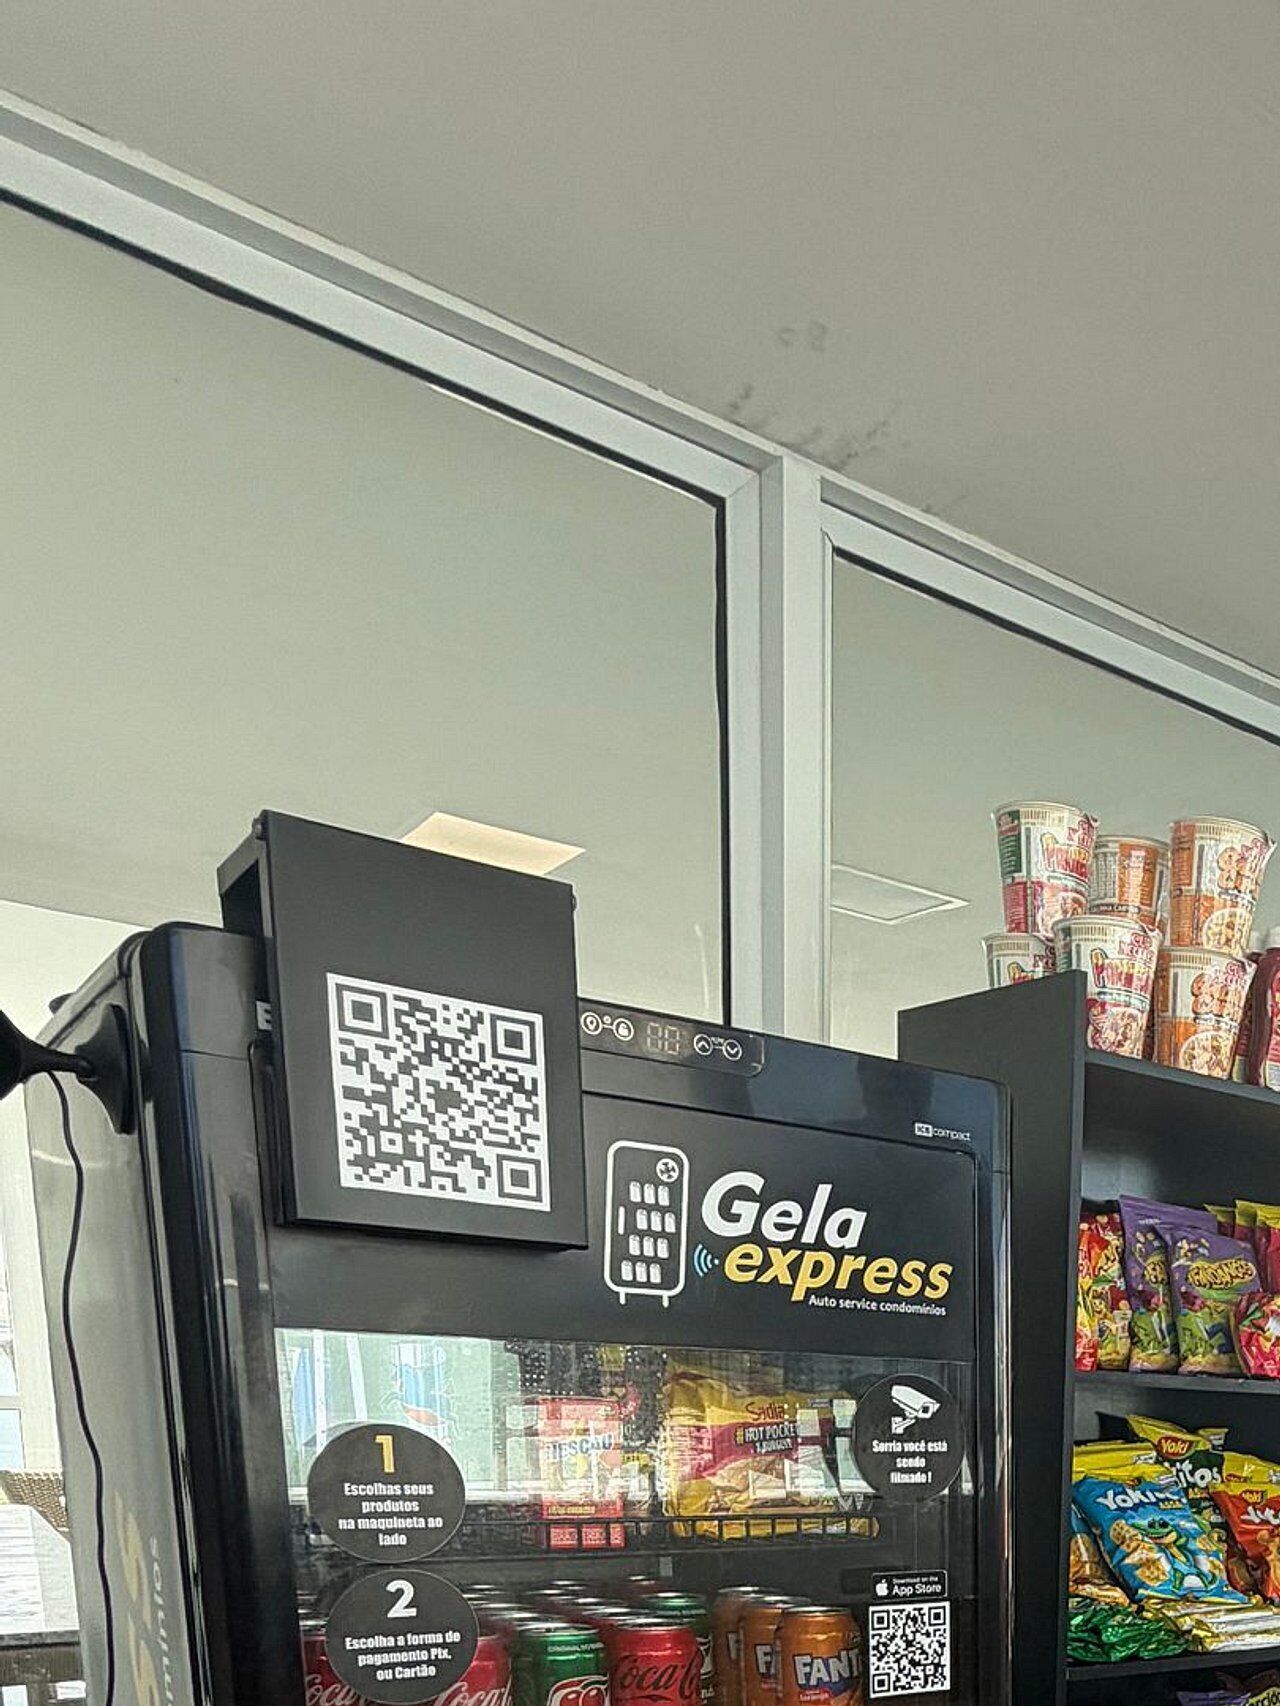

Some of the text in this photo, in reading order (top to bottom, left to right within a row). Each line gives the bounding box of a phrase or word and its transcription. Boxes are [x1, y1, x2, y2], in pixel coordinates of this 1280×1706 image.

[701, 1170, 868, 1250] Gela
[724, 1242, 955, 1302] express
[809, 1294, 836, 1308] Auto
[839, 1298, 876, 1311] service
[746, 1401, 784, 1421] Sadia
[766, 1423, 797, 1440] POCKE
[374, 1434, 395, 1473] 1
[872, 1439, 948, 1453] Sorria você está
[896, 1456, 926, 1468] sendo
[890, 1471, 927, 1484] filmado
[344, 1482, 434, 1497] Escolhas seus
[361, 1500, 420, 1514] produtos
[338, 1517, 443, 1530] na maquineta ao
[378, 1533, 408, 1547] lado
[893, 1581, 942, 1598] App Store
[386, 1579, 418, 1619] 2
[345, 1630, 461, 1651] Escolha a forma de
[358, 1649, 428, 1667] pagamento
[376, 1664, 437, 1681] ou Cartão
[793, 1649, 864, 1686] FANT
